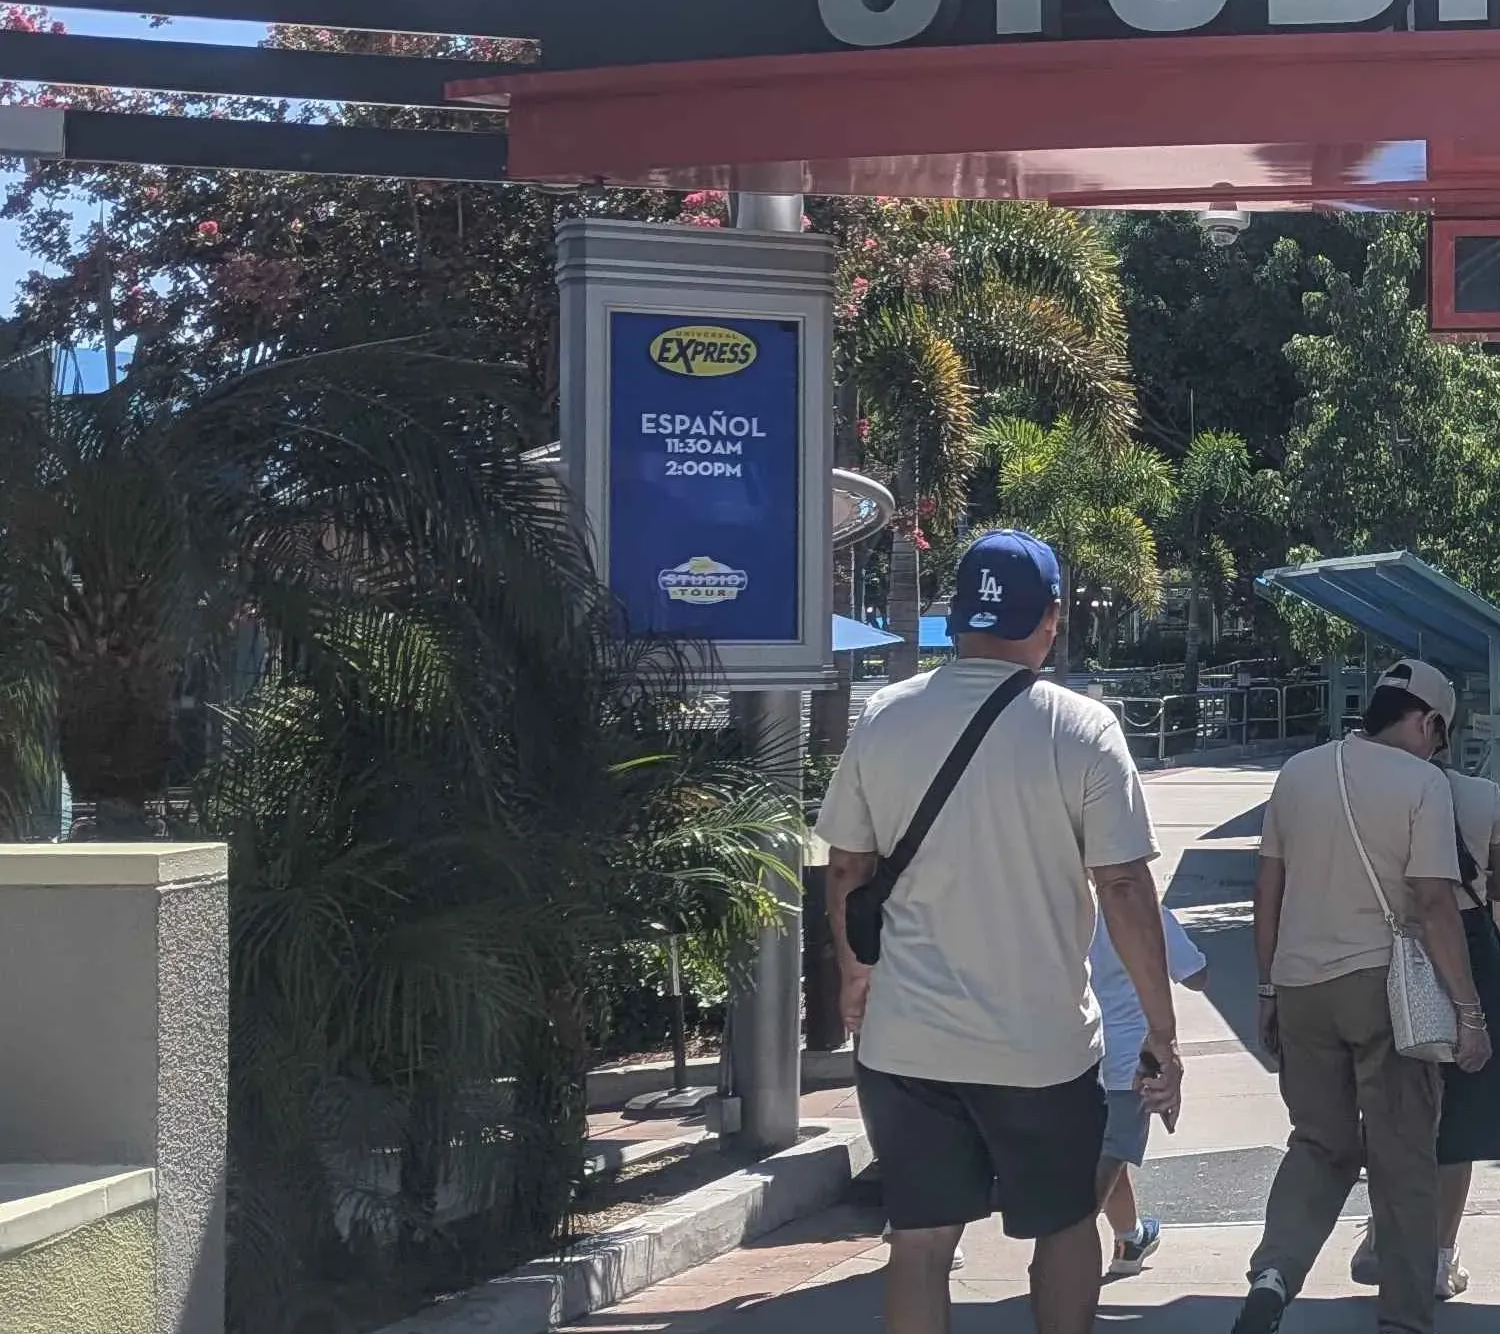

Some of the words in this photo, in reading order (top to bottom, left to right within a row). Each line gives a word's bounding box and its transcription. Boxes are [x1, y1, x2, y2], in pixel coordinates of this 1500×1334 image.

[675, 330, 738, 340] UNIVERSAL
[657, 338, 752, 374] EXPRESS
[641, 410, 768, 438] ESPAÑOL
[664, 438, 743, 455] 11:30AM
[664, 460, 743, 478] 2:00PM
[664, 573, 741, 586] STUDIO
[978, 568, 1004, 603] LA
[678, 588, 727, 597] TOUR
